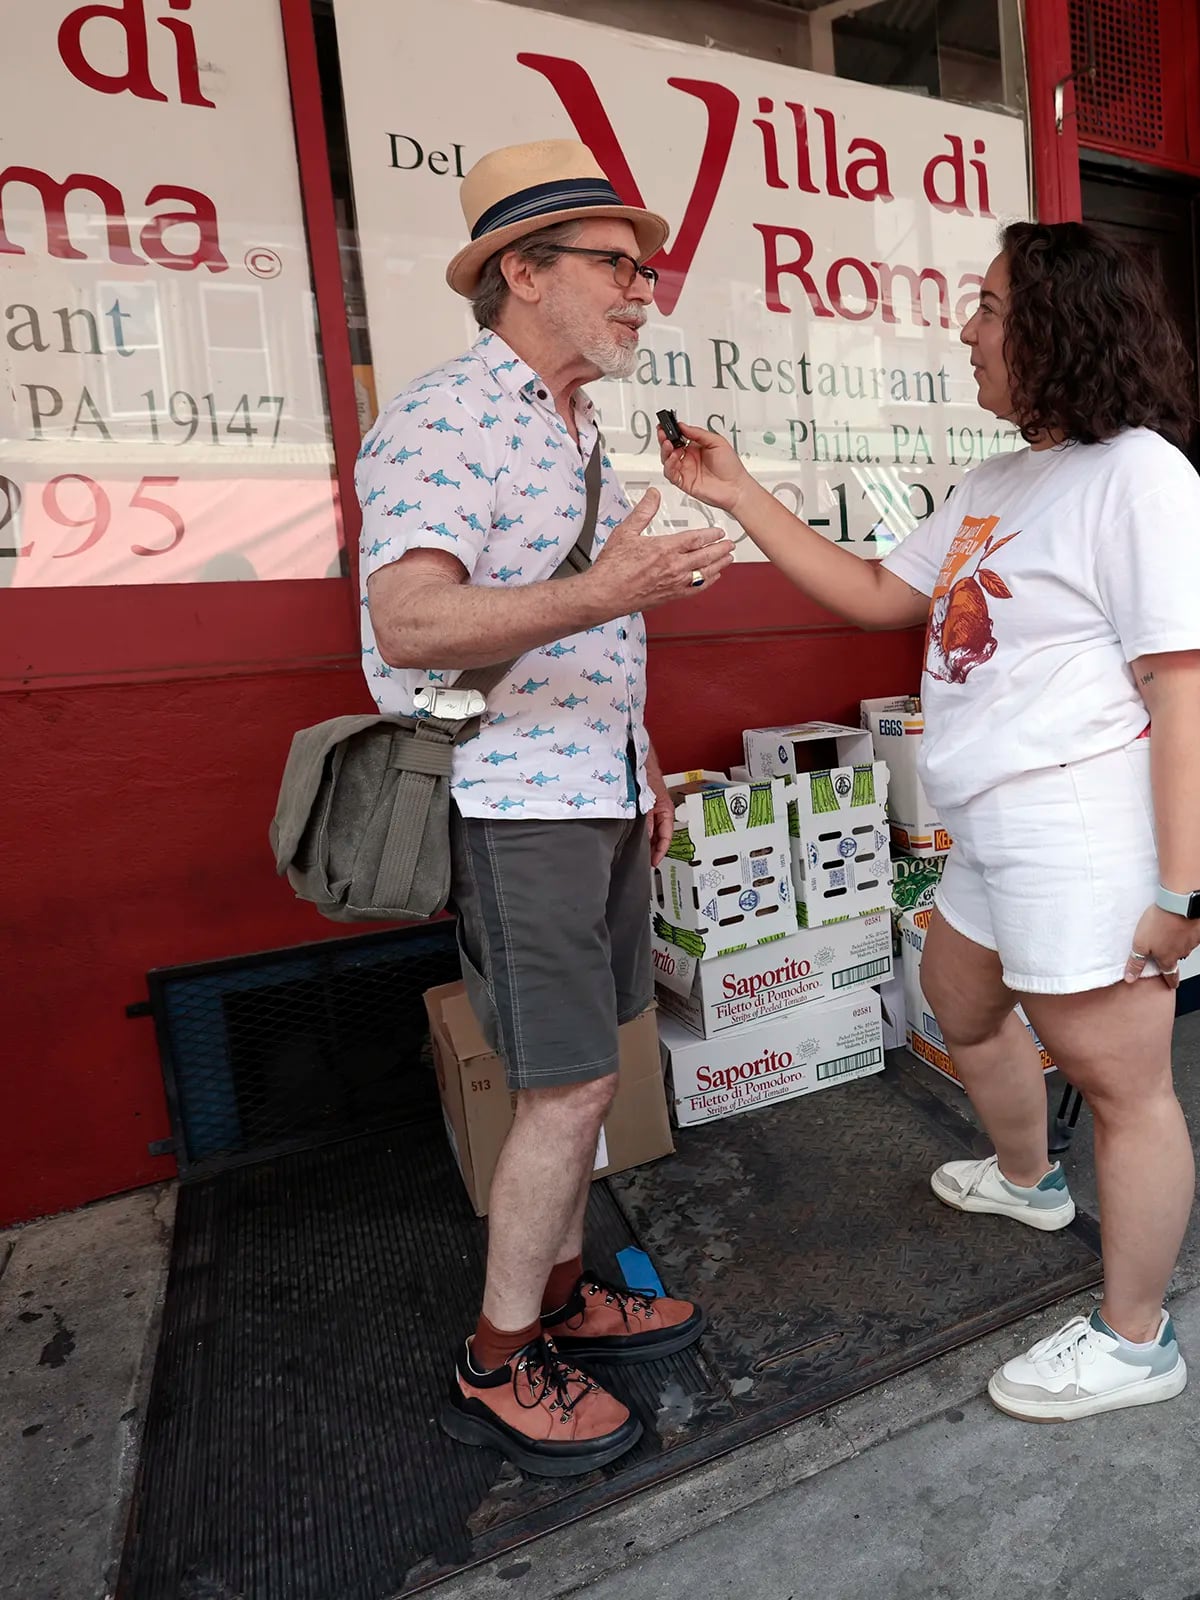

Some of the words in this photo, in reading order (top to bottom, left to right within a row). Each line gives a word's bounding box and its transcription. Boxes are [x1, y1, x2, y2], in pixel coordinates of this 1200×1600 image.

[58, 0, 216, 109] di
[517, 53, 895, 316] Villa
[923, 134, 997, 220] di
[5, 298, 136, 357] ant
[709, 338, 953, 404] Restaurant
[21, 384, 117, 442] PA
[141, 389, 285, 448] 19147
[786, 418, 880, 464] Phila.
[891, 424, 936, 465] PA
[879, 719, 903, 737] EGGS
[722, 957, 811, 998] Saporito
[716, 999, 752, 1019] Filetto
[754, 992, 765, 1008] di
[767, 979, 820, 1004] Pomodoro
[731, 1011, 752, 1024] Strips
[760, 1002, 782, 1014] Peeled
[471, 1080, 491, 1092] 513
[696, 1049, 793, 1091] Saporito
[690, 1093, 729, 1111] Filetto
[731, 1085, 742, 1098] di
[745, 1071, 802, 1096] Pomodoro
[707, 1104, 729, 1116] Strips
[738, 1094, 762, 1107] Peeled
[763, 1086, 789, 1099] Tomato
